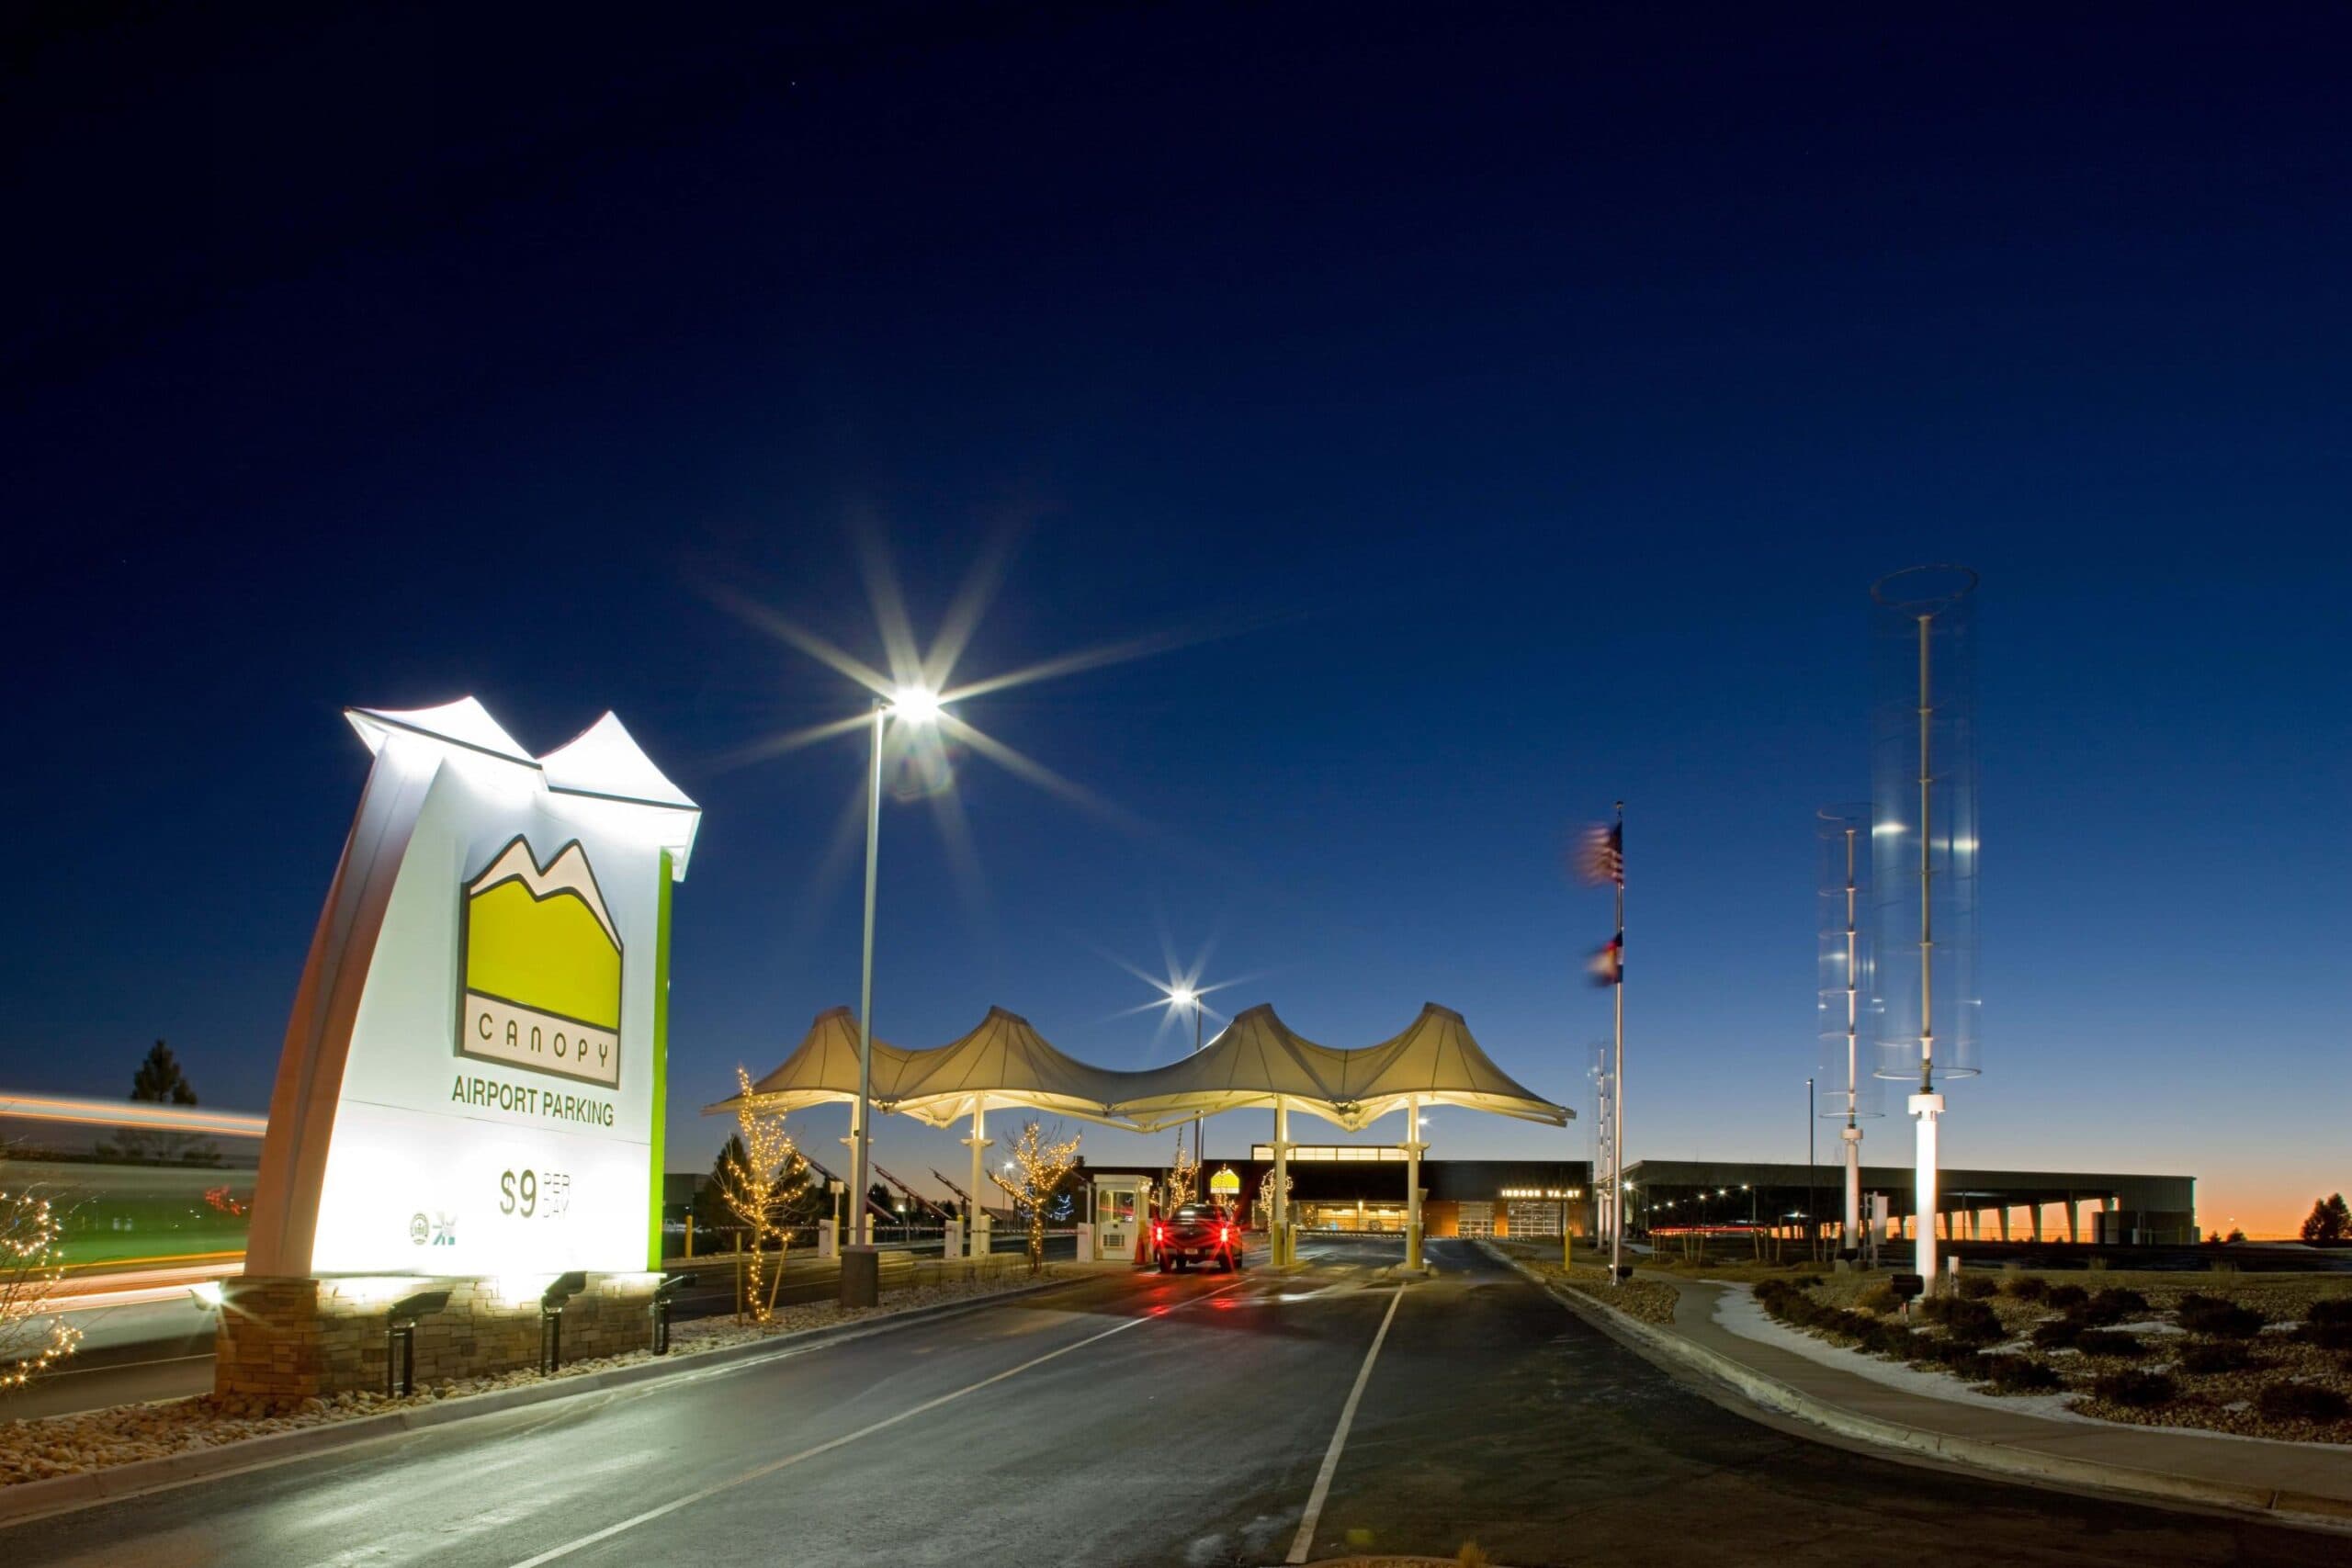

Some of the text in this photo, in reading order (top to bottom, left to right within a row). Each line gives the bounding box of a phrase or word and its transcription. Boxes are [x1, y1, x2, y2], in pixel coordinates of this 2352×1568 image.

[479, 1013, 608, 1067] CANOPY
[452, 1076, 614, 1126] AIRPORT PARKING
[500, 1168, 537, 1219] $9
